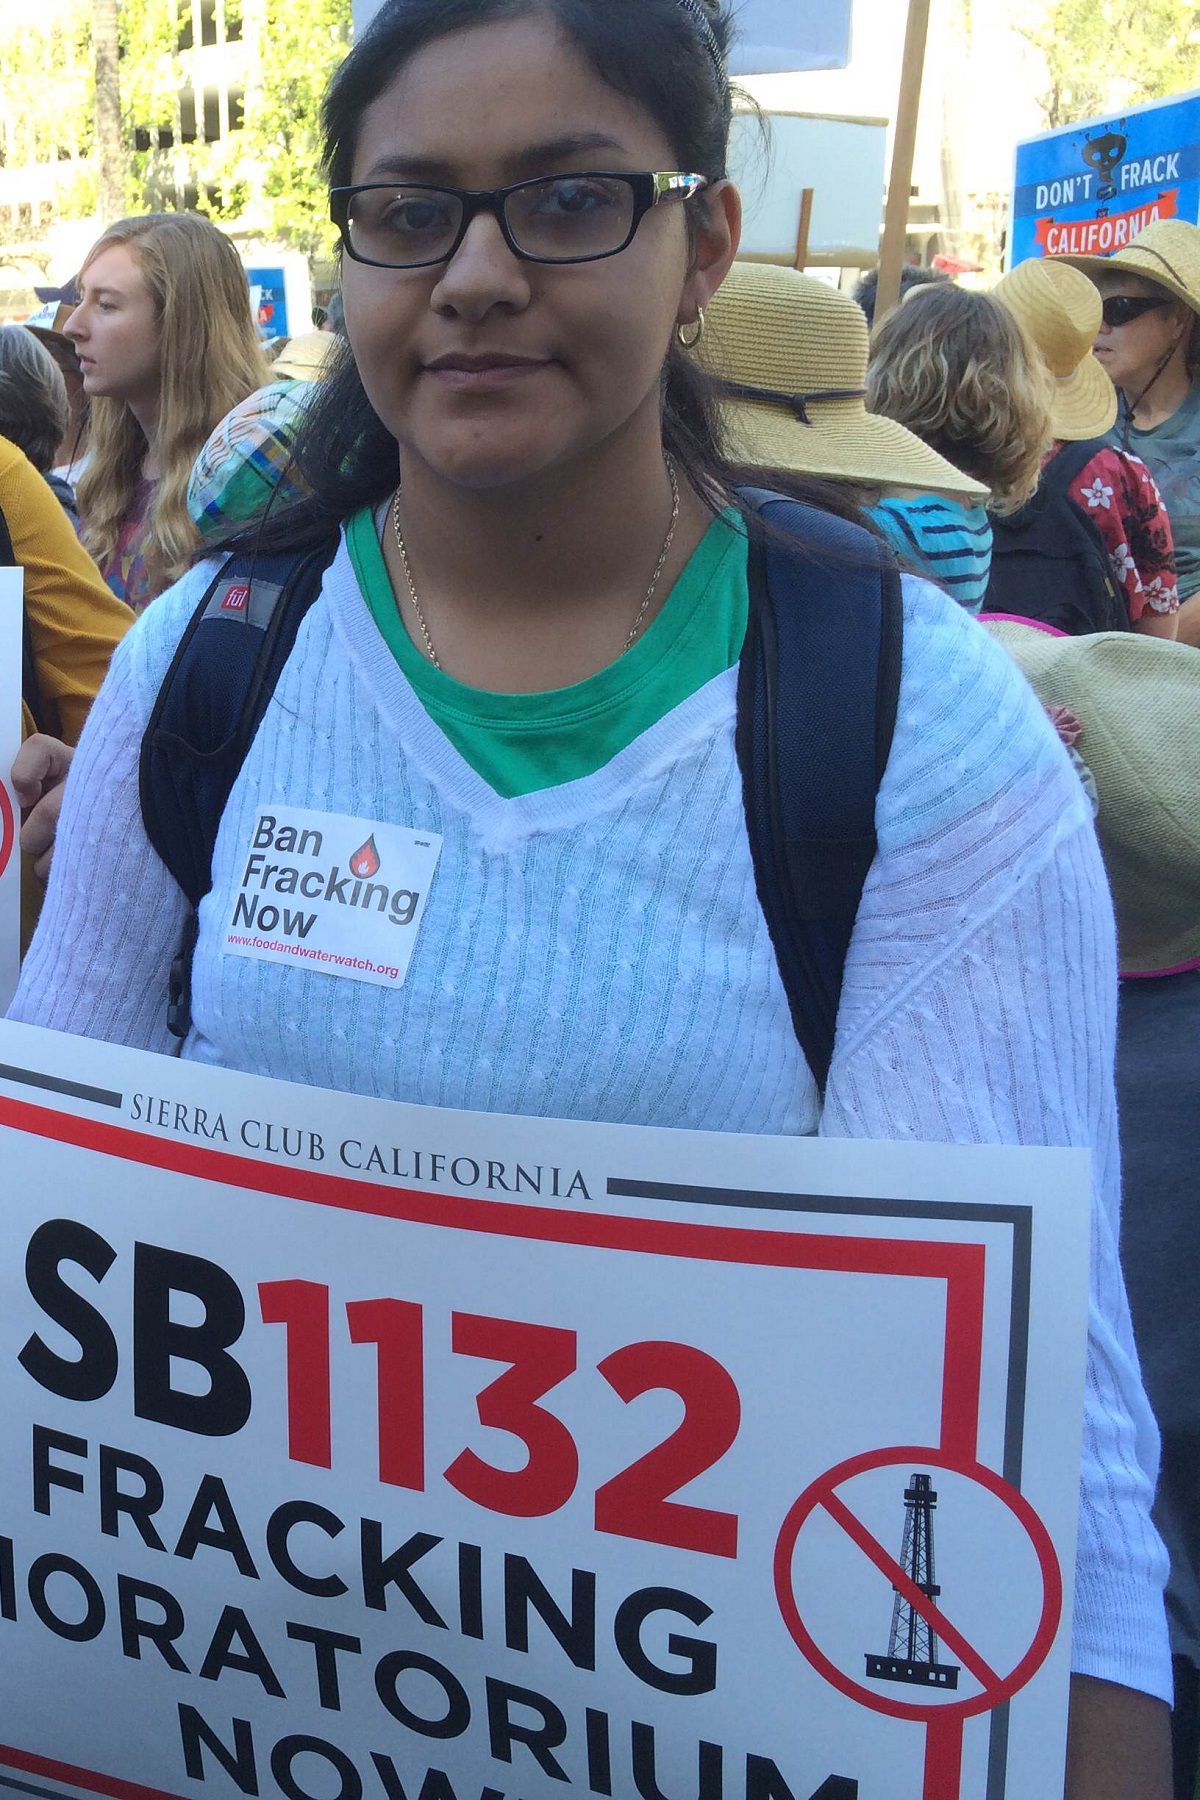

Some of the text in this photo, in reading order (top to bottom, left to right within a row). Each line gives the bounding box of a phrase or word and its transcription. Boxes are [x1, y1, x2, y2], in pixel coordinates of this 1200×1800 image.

[1036, 152, 1180, 209] DON'T FRACK
[1047, 206, 1161, 254] CALIFORNIA
[253, 815, 323, 857] Ban
[232, 893, 318, 939] Now
[242, 854, 420, 925] Fracking
[227, 934, 400, 979] www.foodandwaterwatch.org
[131, 1093, 593, 1200] SIERRA CLUB CALIFORNIA
[17, 1219, 740, 1559] SB1132
[33, 1424, 717, 1697] FRACKING
